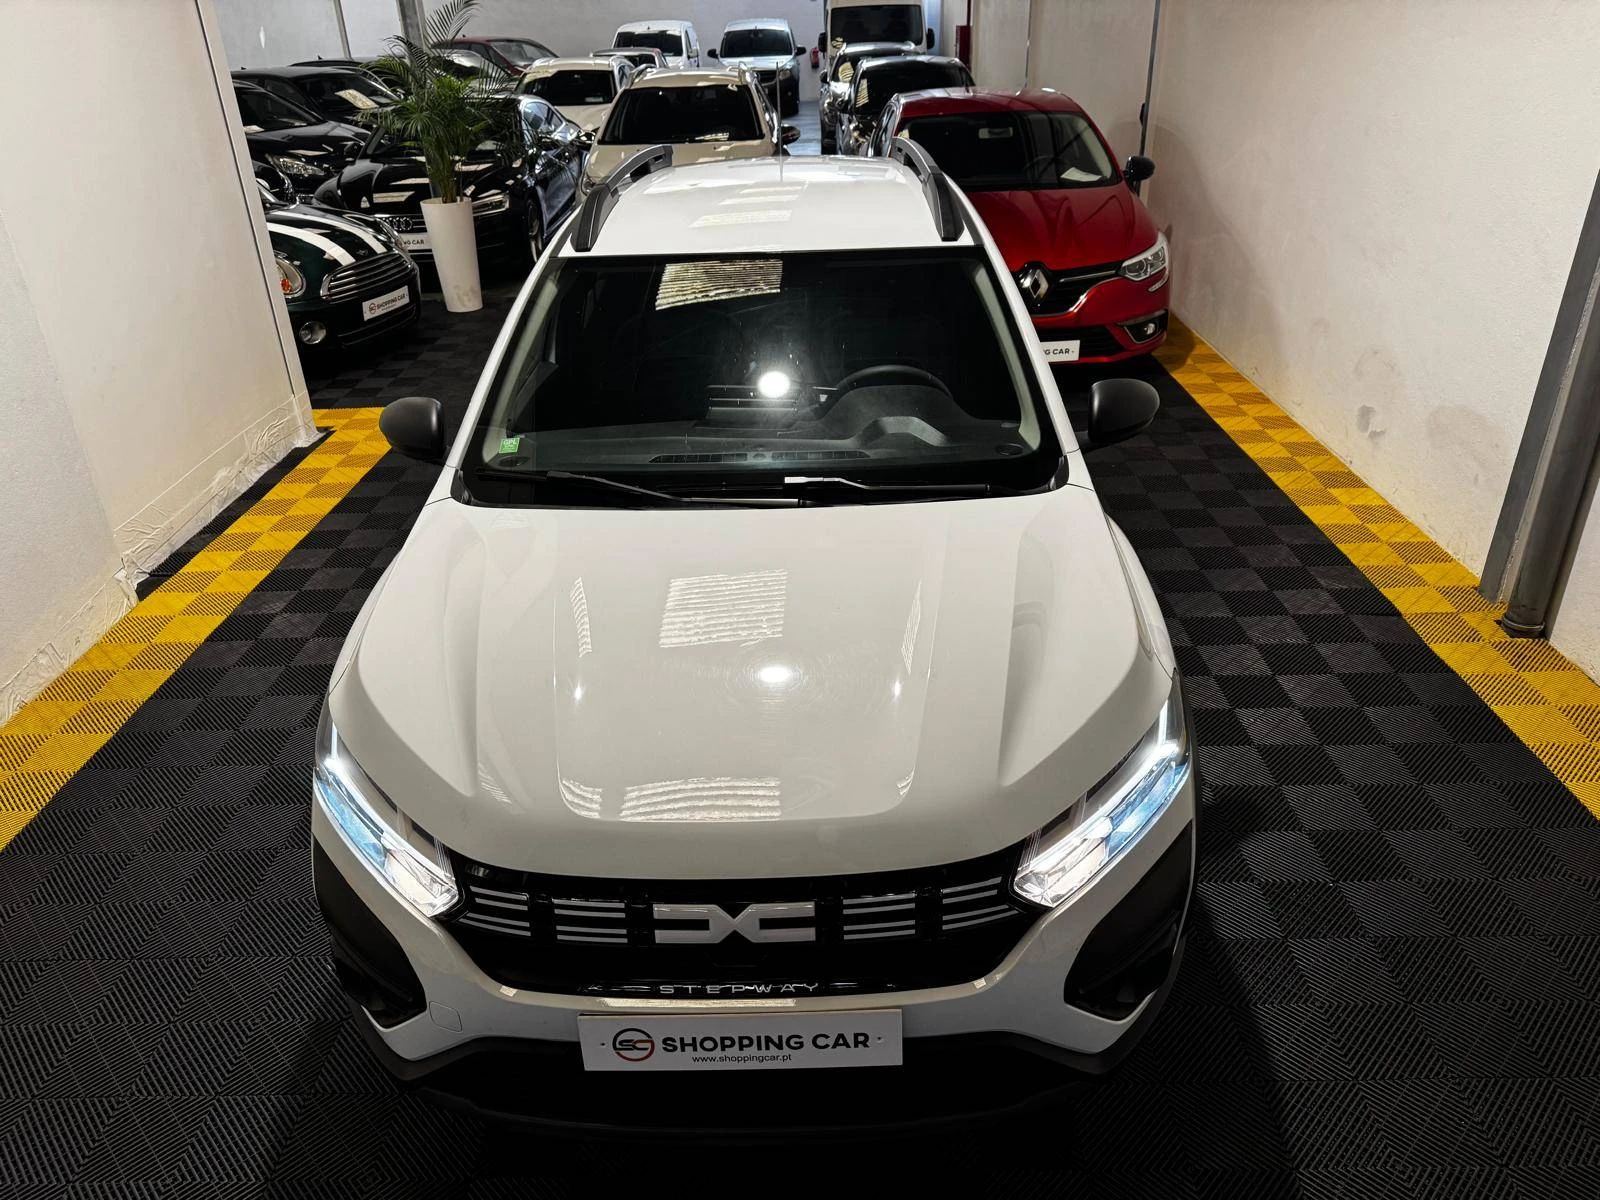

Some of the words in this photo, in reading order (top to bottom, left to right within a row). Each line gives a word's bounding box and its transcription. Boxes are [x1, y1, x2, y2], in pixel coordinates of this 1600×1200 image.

[659, 983, 819, 994] STEPWAY
[661, 1034, 805, 1053] SHOPPING
[811, 1032, 870, 1049] CAR
[691, 1053, 792, 1063] www.shoppingcar.pt
